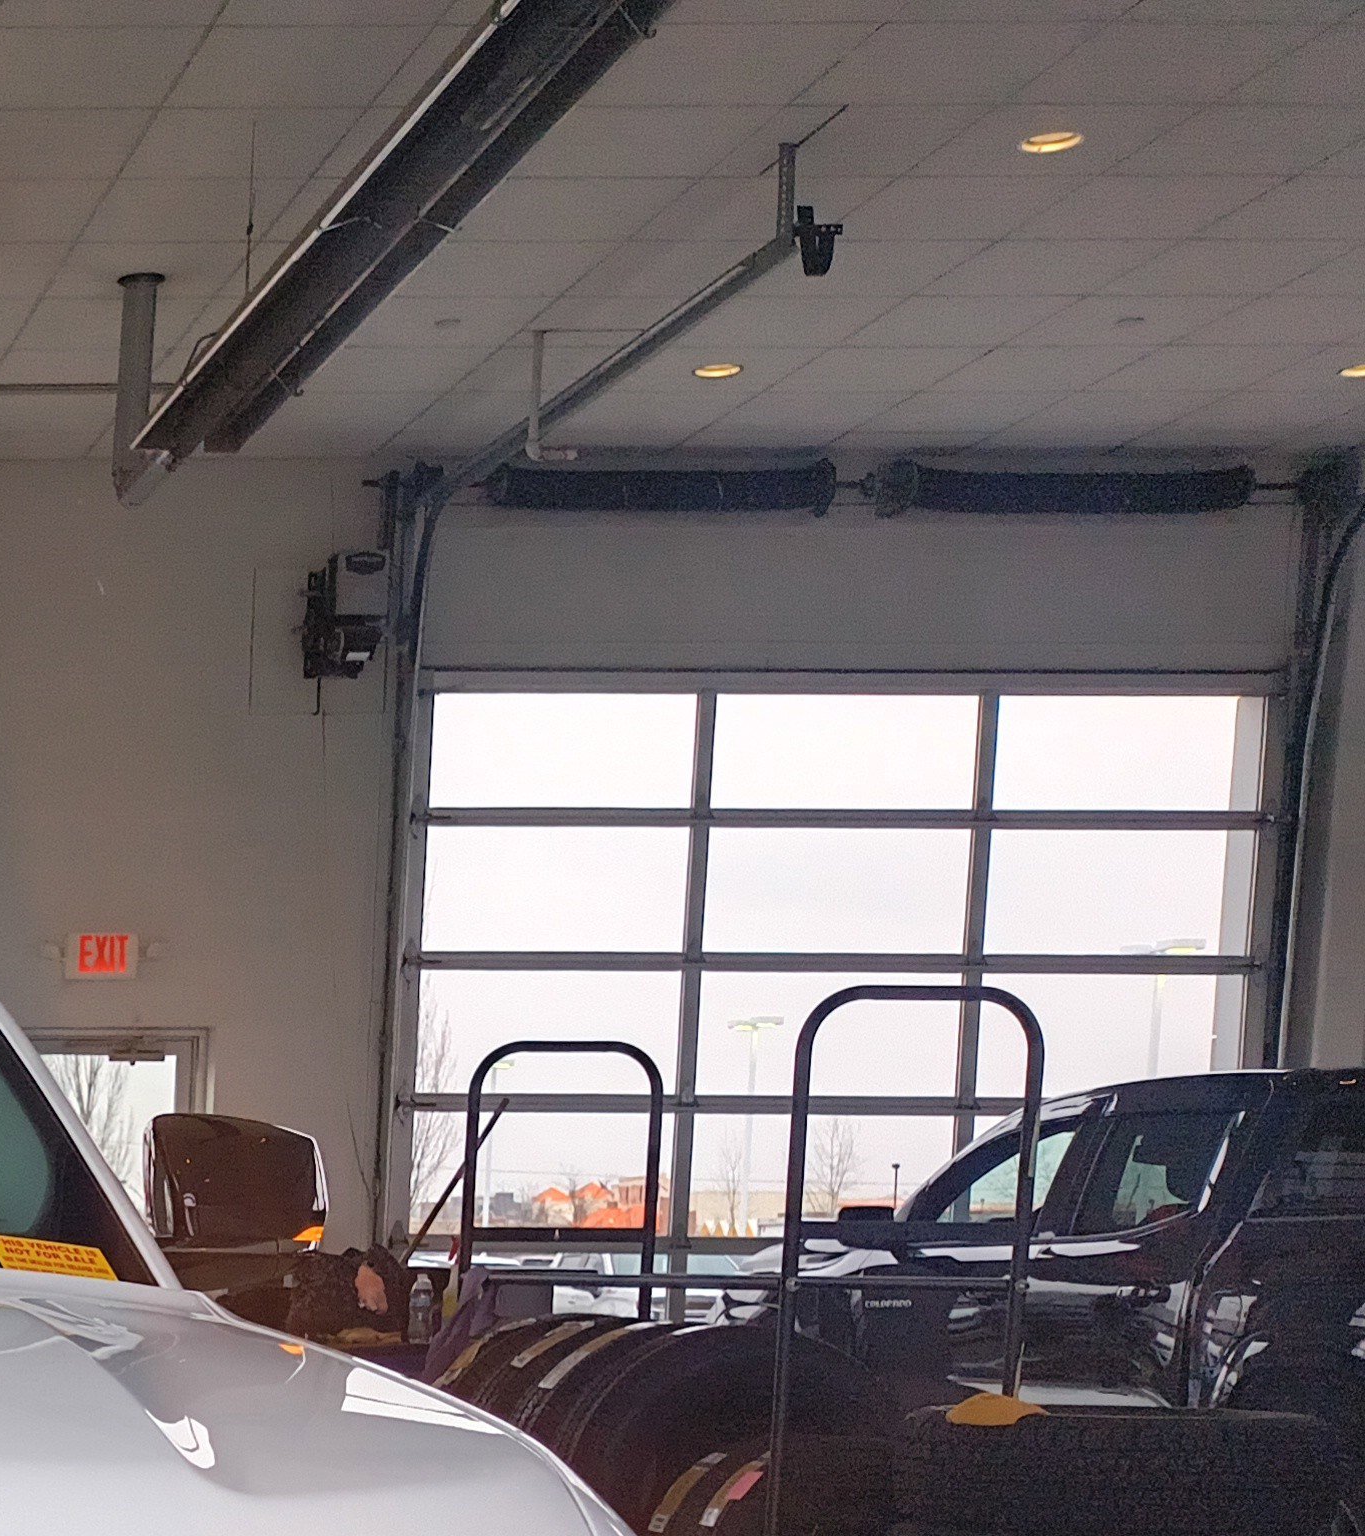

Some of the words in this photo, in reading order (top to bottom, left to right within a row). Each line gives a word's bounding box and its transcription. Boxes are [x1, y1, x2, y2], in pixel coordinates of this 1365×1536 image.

[78, 934, 129, 973] EXIT
[4, 1246, 31, 1256] NOT
[35, 1250, 61, 1260] FOR
[64, 1253, 97, 1264] SALE
[26, 1240, 81, 1255] VEHICLE
[84, 1249, 97, 1258] IS
